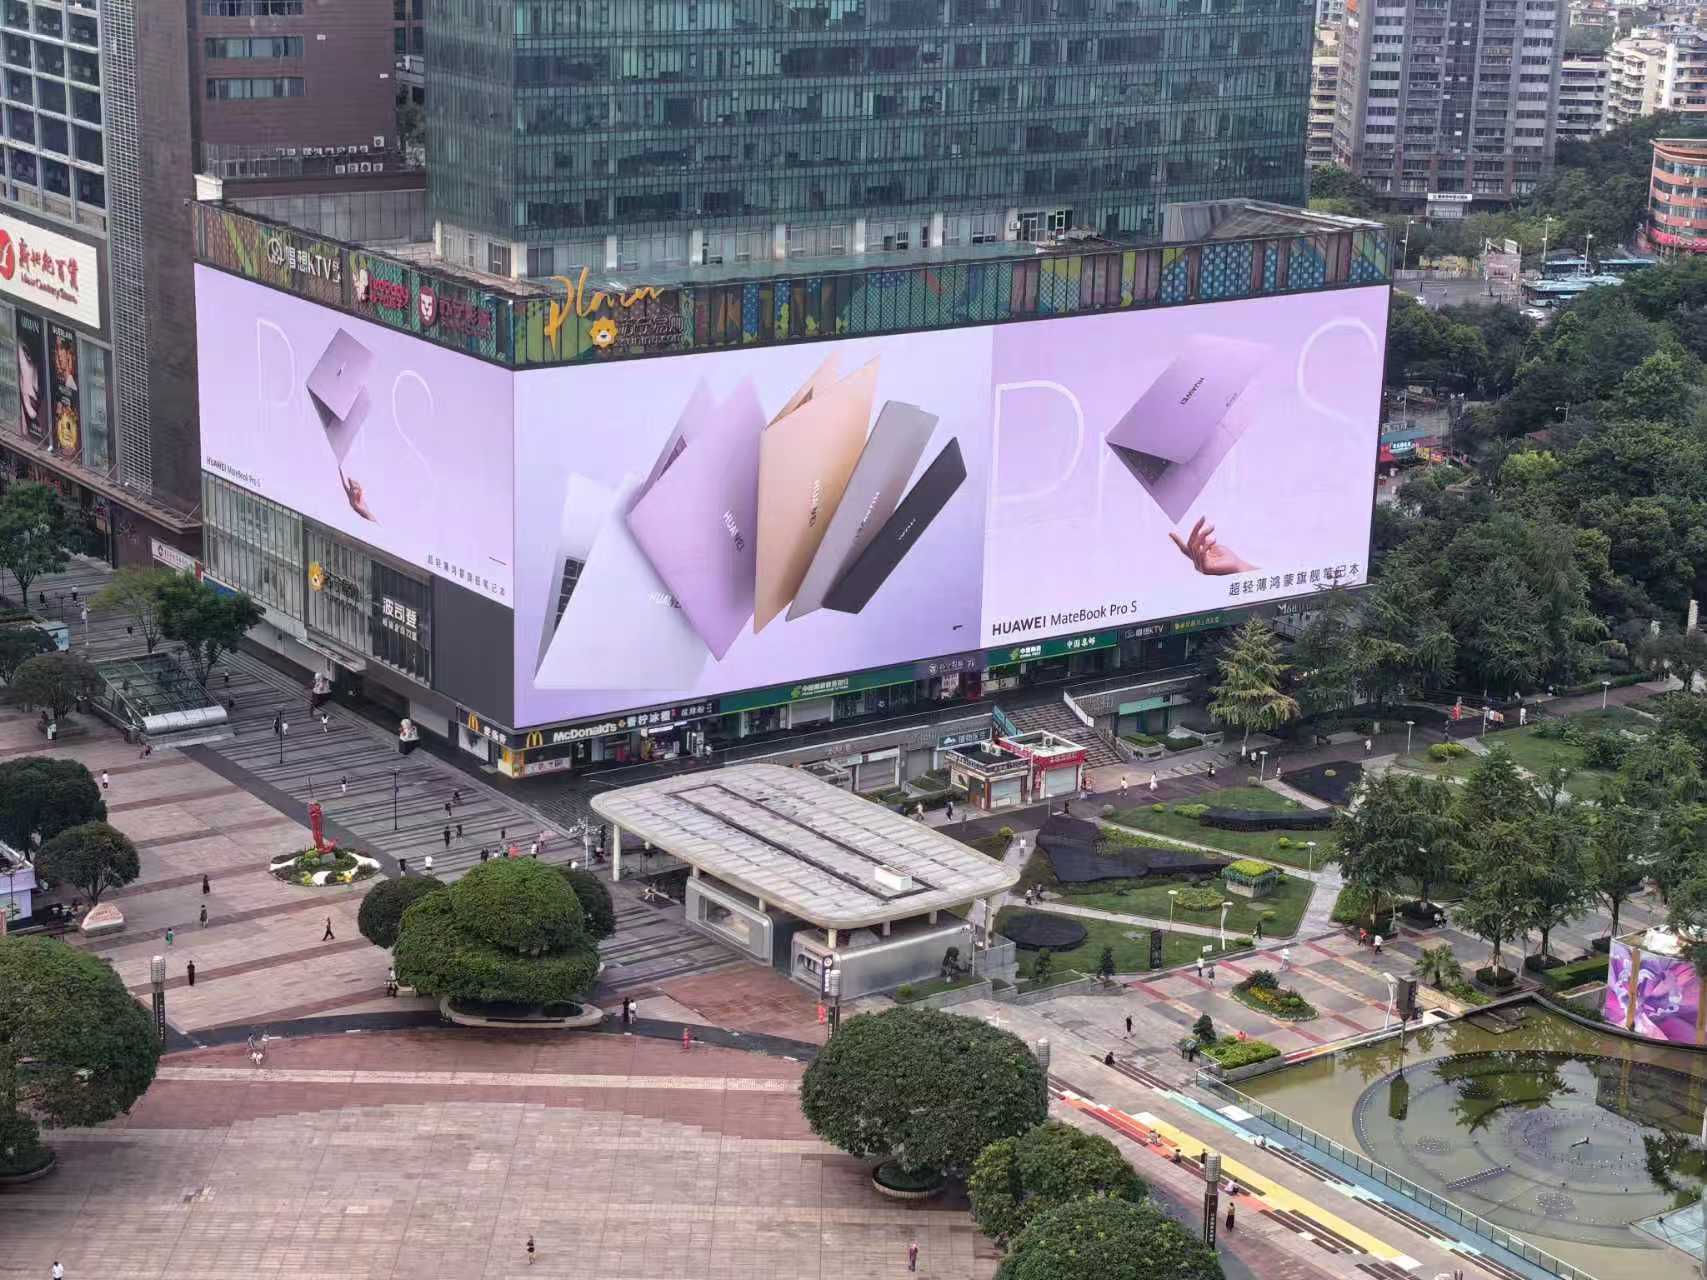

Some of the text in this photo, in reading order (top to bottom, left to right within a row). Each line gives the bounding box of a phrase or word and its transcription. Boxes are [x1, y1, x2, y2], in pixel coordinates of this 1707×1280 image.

[18, 237, 79, 292] 新世纪百货
[206, 456, 226, 472] HUAWEI
[1229, 563, 1360, 596] 超轻薄鸿蒙旗舰笔记本
[383, 597, 418, 629] 波司登
[992, 600, 1138, 636] HUAWEI MateBook Pro S
[552, 719, 618, 743] McDonald's
